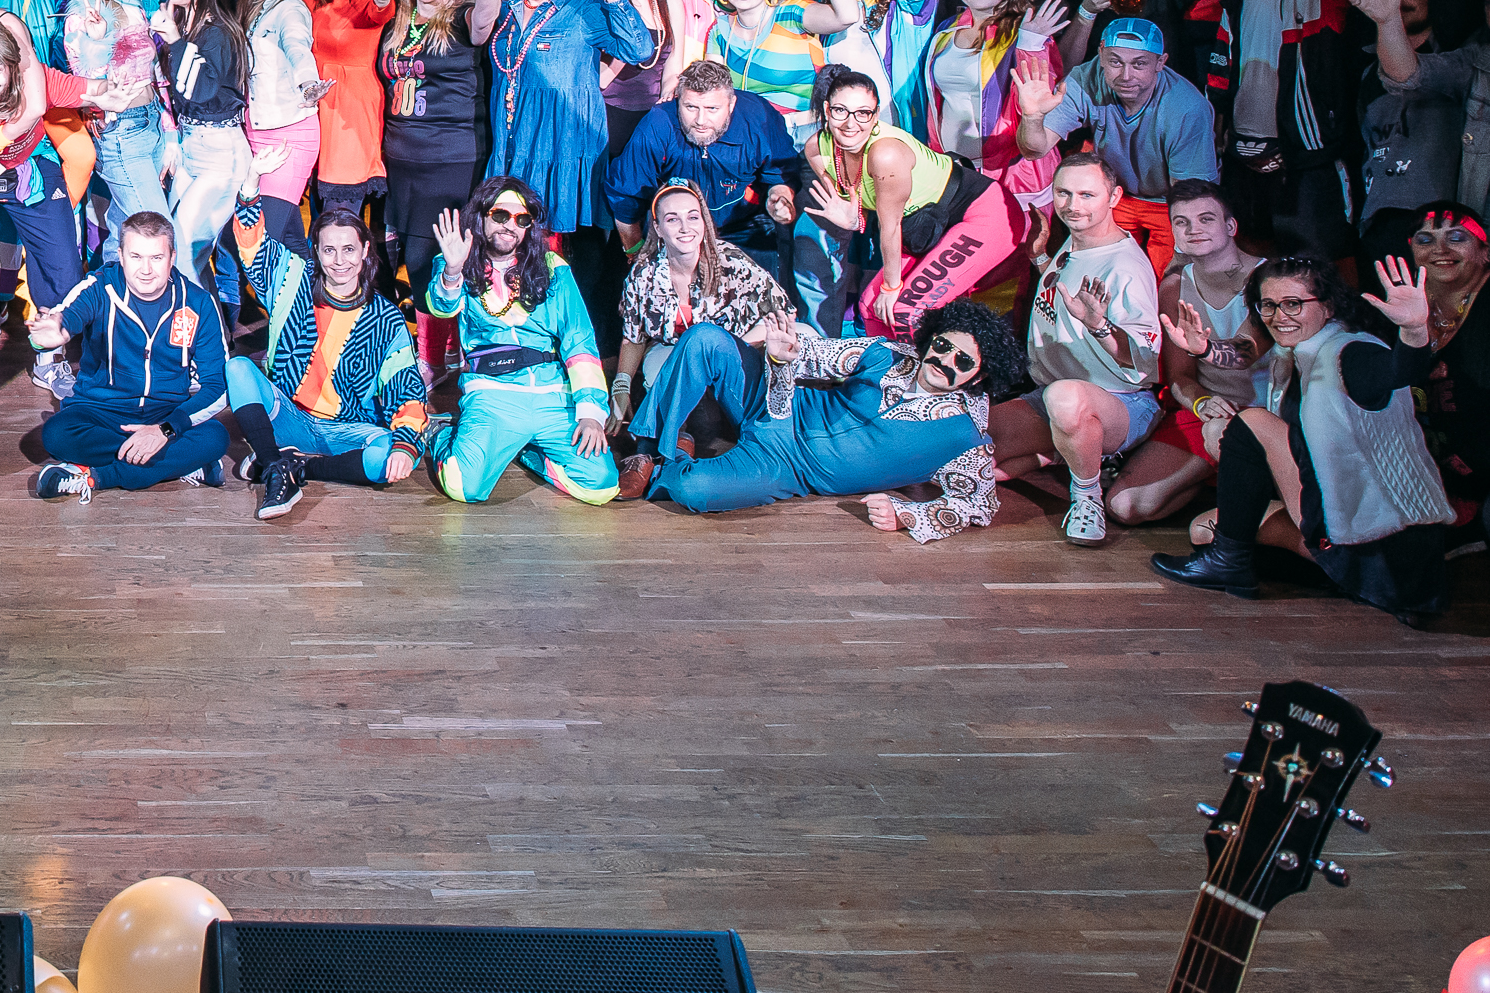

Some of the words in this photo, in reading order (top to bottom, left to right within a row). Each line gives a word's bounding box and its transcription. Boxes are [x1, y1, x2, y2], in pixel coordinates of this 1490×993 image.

[897, 233, 985, 308] ROUGH
[921, 277, 956, 308] LADY
[1288, 702, 1340, 737] YAMAHA
